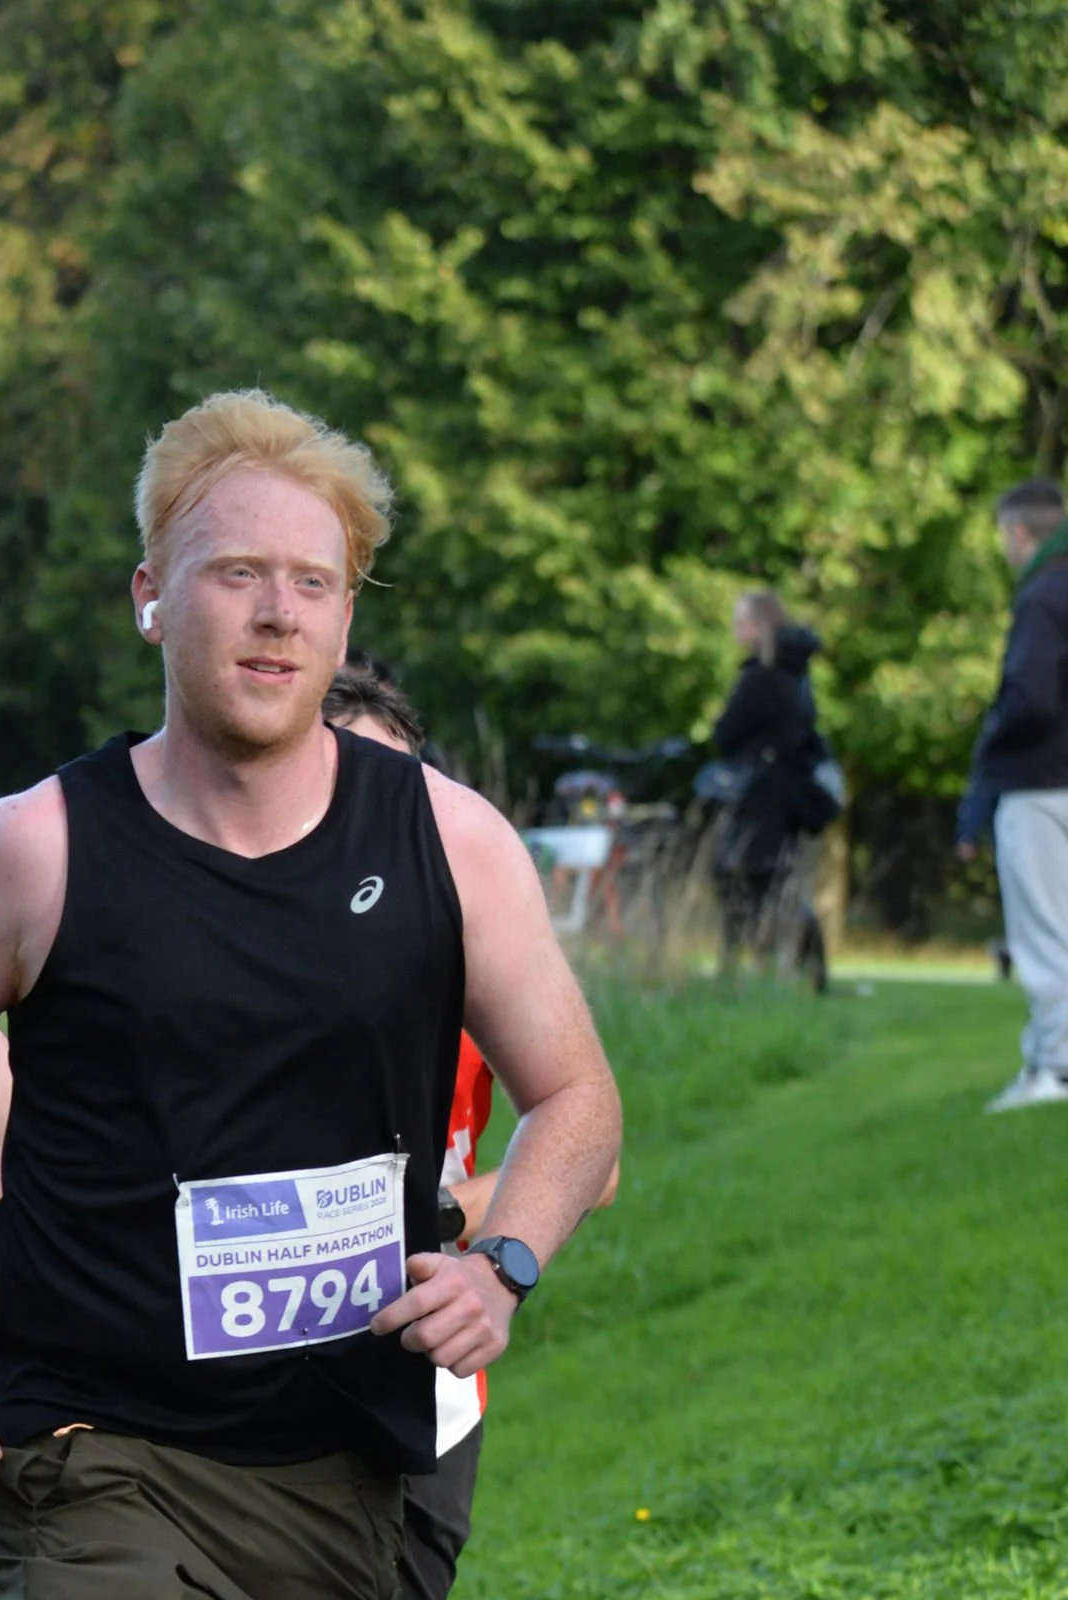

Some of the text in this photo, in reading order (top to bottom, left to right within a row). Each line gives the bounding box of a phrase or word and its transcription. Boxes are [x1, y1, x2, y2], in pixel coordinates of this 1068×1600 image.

[316, 1175, 386, 1208] DUBLIN
[226, 1200, 290, 1220] Irish Life
[316, 1208, 341, 1220] RACE
[196, 1223, 394, 1268] DUBLIN HALF MARATHON
[220, 1259, 383, 1338] 8794
